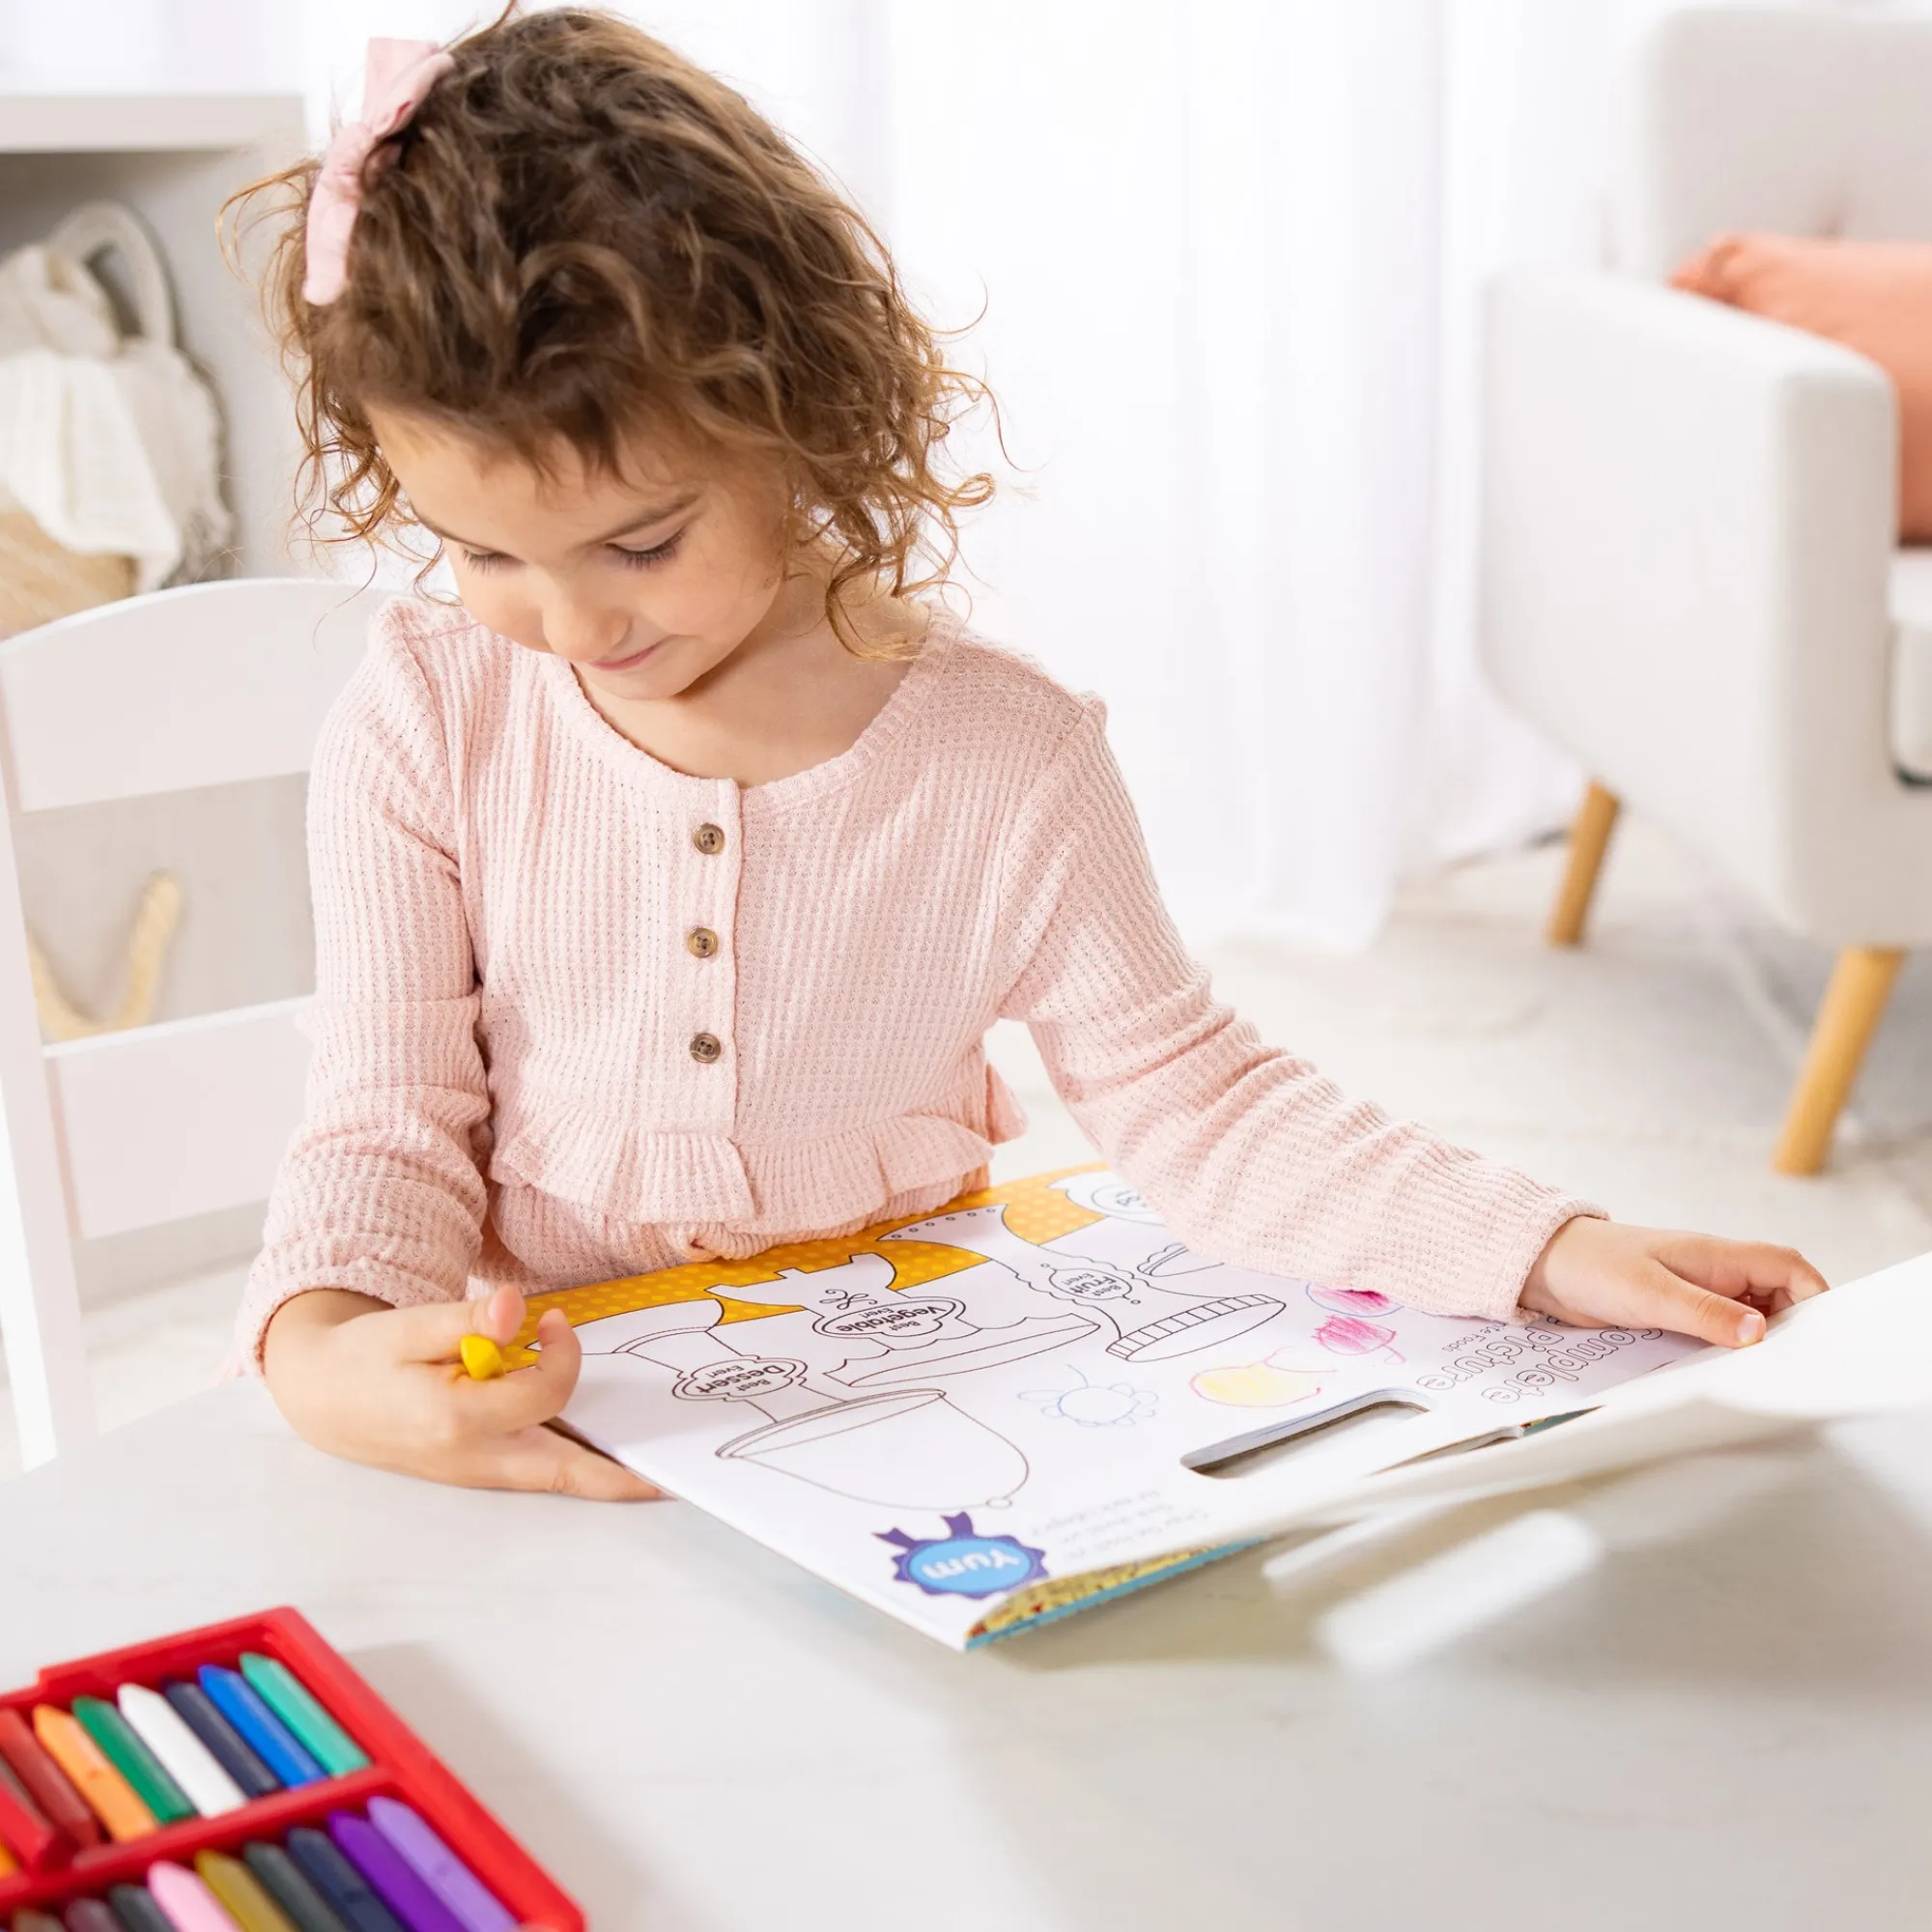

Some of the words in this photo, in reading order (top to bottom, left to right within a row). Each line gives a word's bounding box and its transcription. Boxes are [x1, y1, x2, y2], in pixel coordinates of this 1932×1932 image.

[1069, 1277, 1117, 1294] Fruit
[836, 1305, 947, 1333] Vegetable
[859, 1308, 895, 1319] Ever!
[889, 1321, 922, 1332] Best
[1442, 1334, 1486, 1352] Foods
[1417, 1326, 1564, 1391] Picture
[695, 1365, 785, 1394] Dessert
[705, 1365, 745, 1378] Ever!
[736, 1378, 771, 1392] Best
[922, 1548, 1021, 1579] Yum
